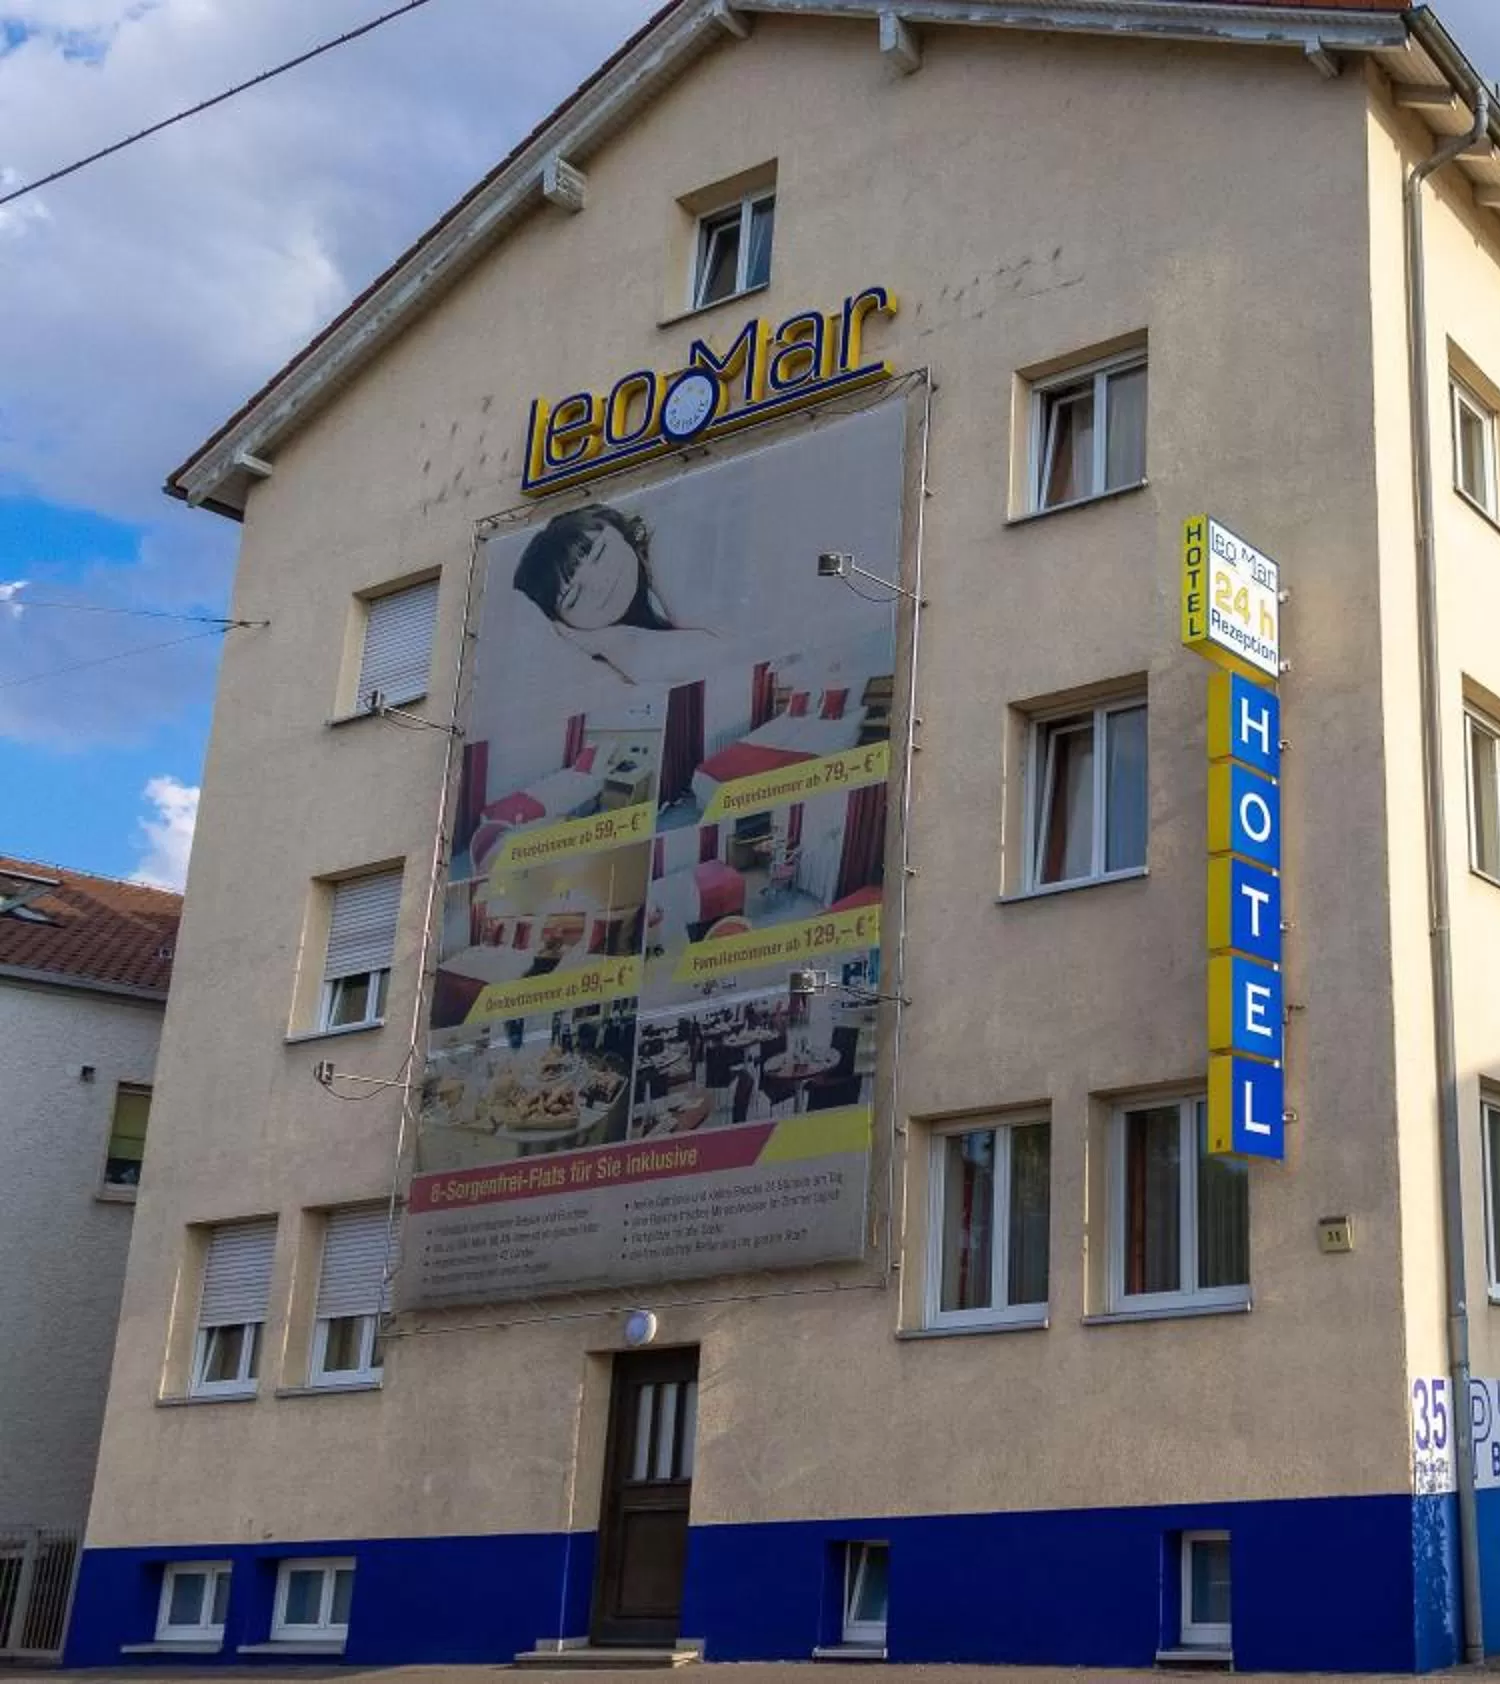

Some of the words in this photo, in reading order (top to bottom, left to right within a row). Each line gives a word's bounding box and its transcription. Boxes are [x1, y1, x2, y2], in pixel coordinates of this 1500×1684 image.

[1187, 524, 1201, 636] HOTEL
[1215, 571, 1251, 626] 24
[1260, 598, 1274, 641] h
[1211, 609, 1277, 664] Rezeption
[1239, 697, 1272, 1135] HOTEL
[570, 1161, 592, 1183] für
[596, 1156, 622, 1180] Sie
[1413, 1379, 1447, 1450] 35
